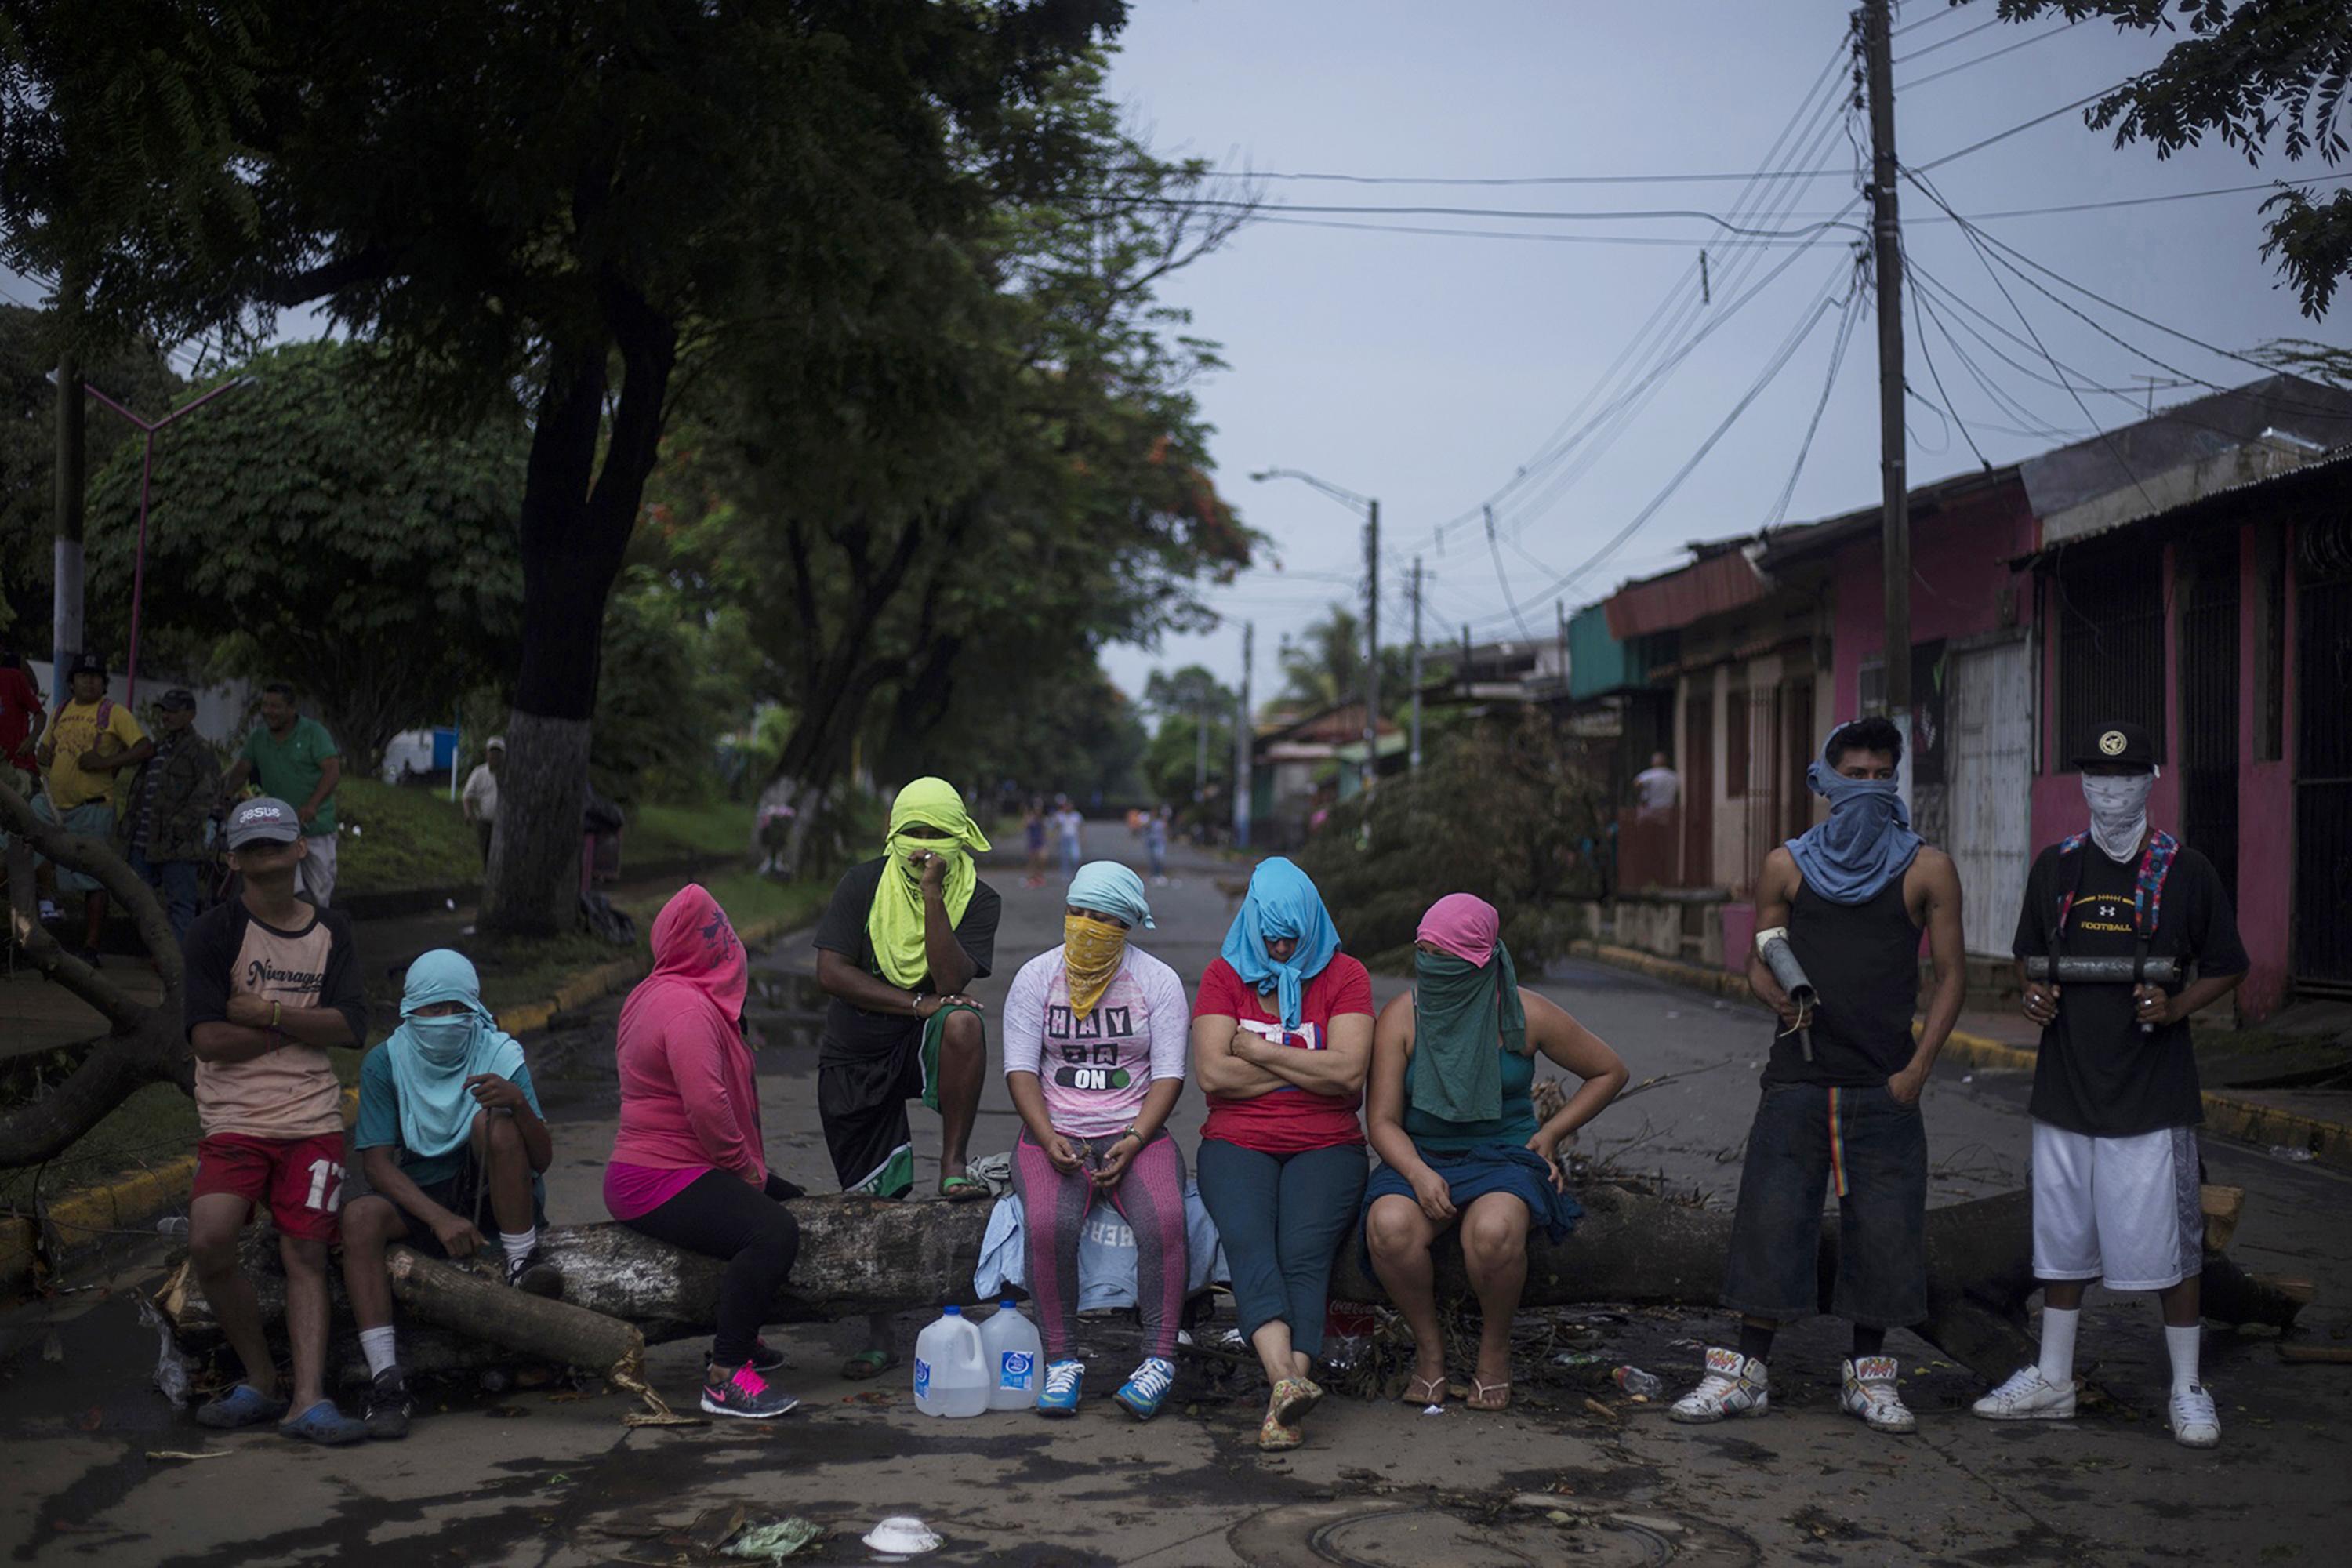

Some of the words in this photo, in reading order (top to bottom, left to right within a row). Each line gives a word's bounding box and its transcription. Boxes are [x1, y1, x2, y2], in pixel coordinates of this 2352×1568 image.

[2081, 922, 2132, 931] FOOTBALL
[1051, 1007, 1127, 1036] HAY
[1075, 1069, 1106, 1090] ON
